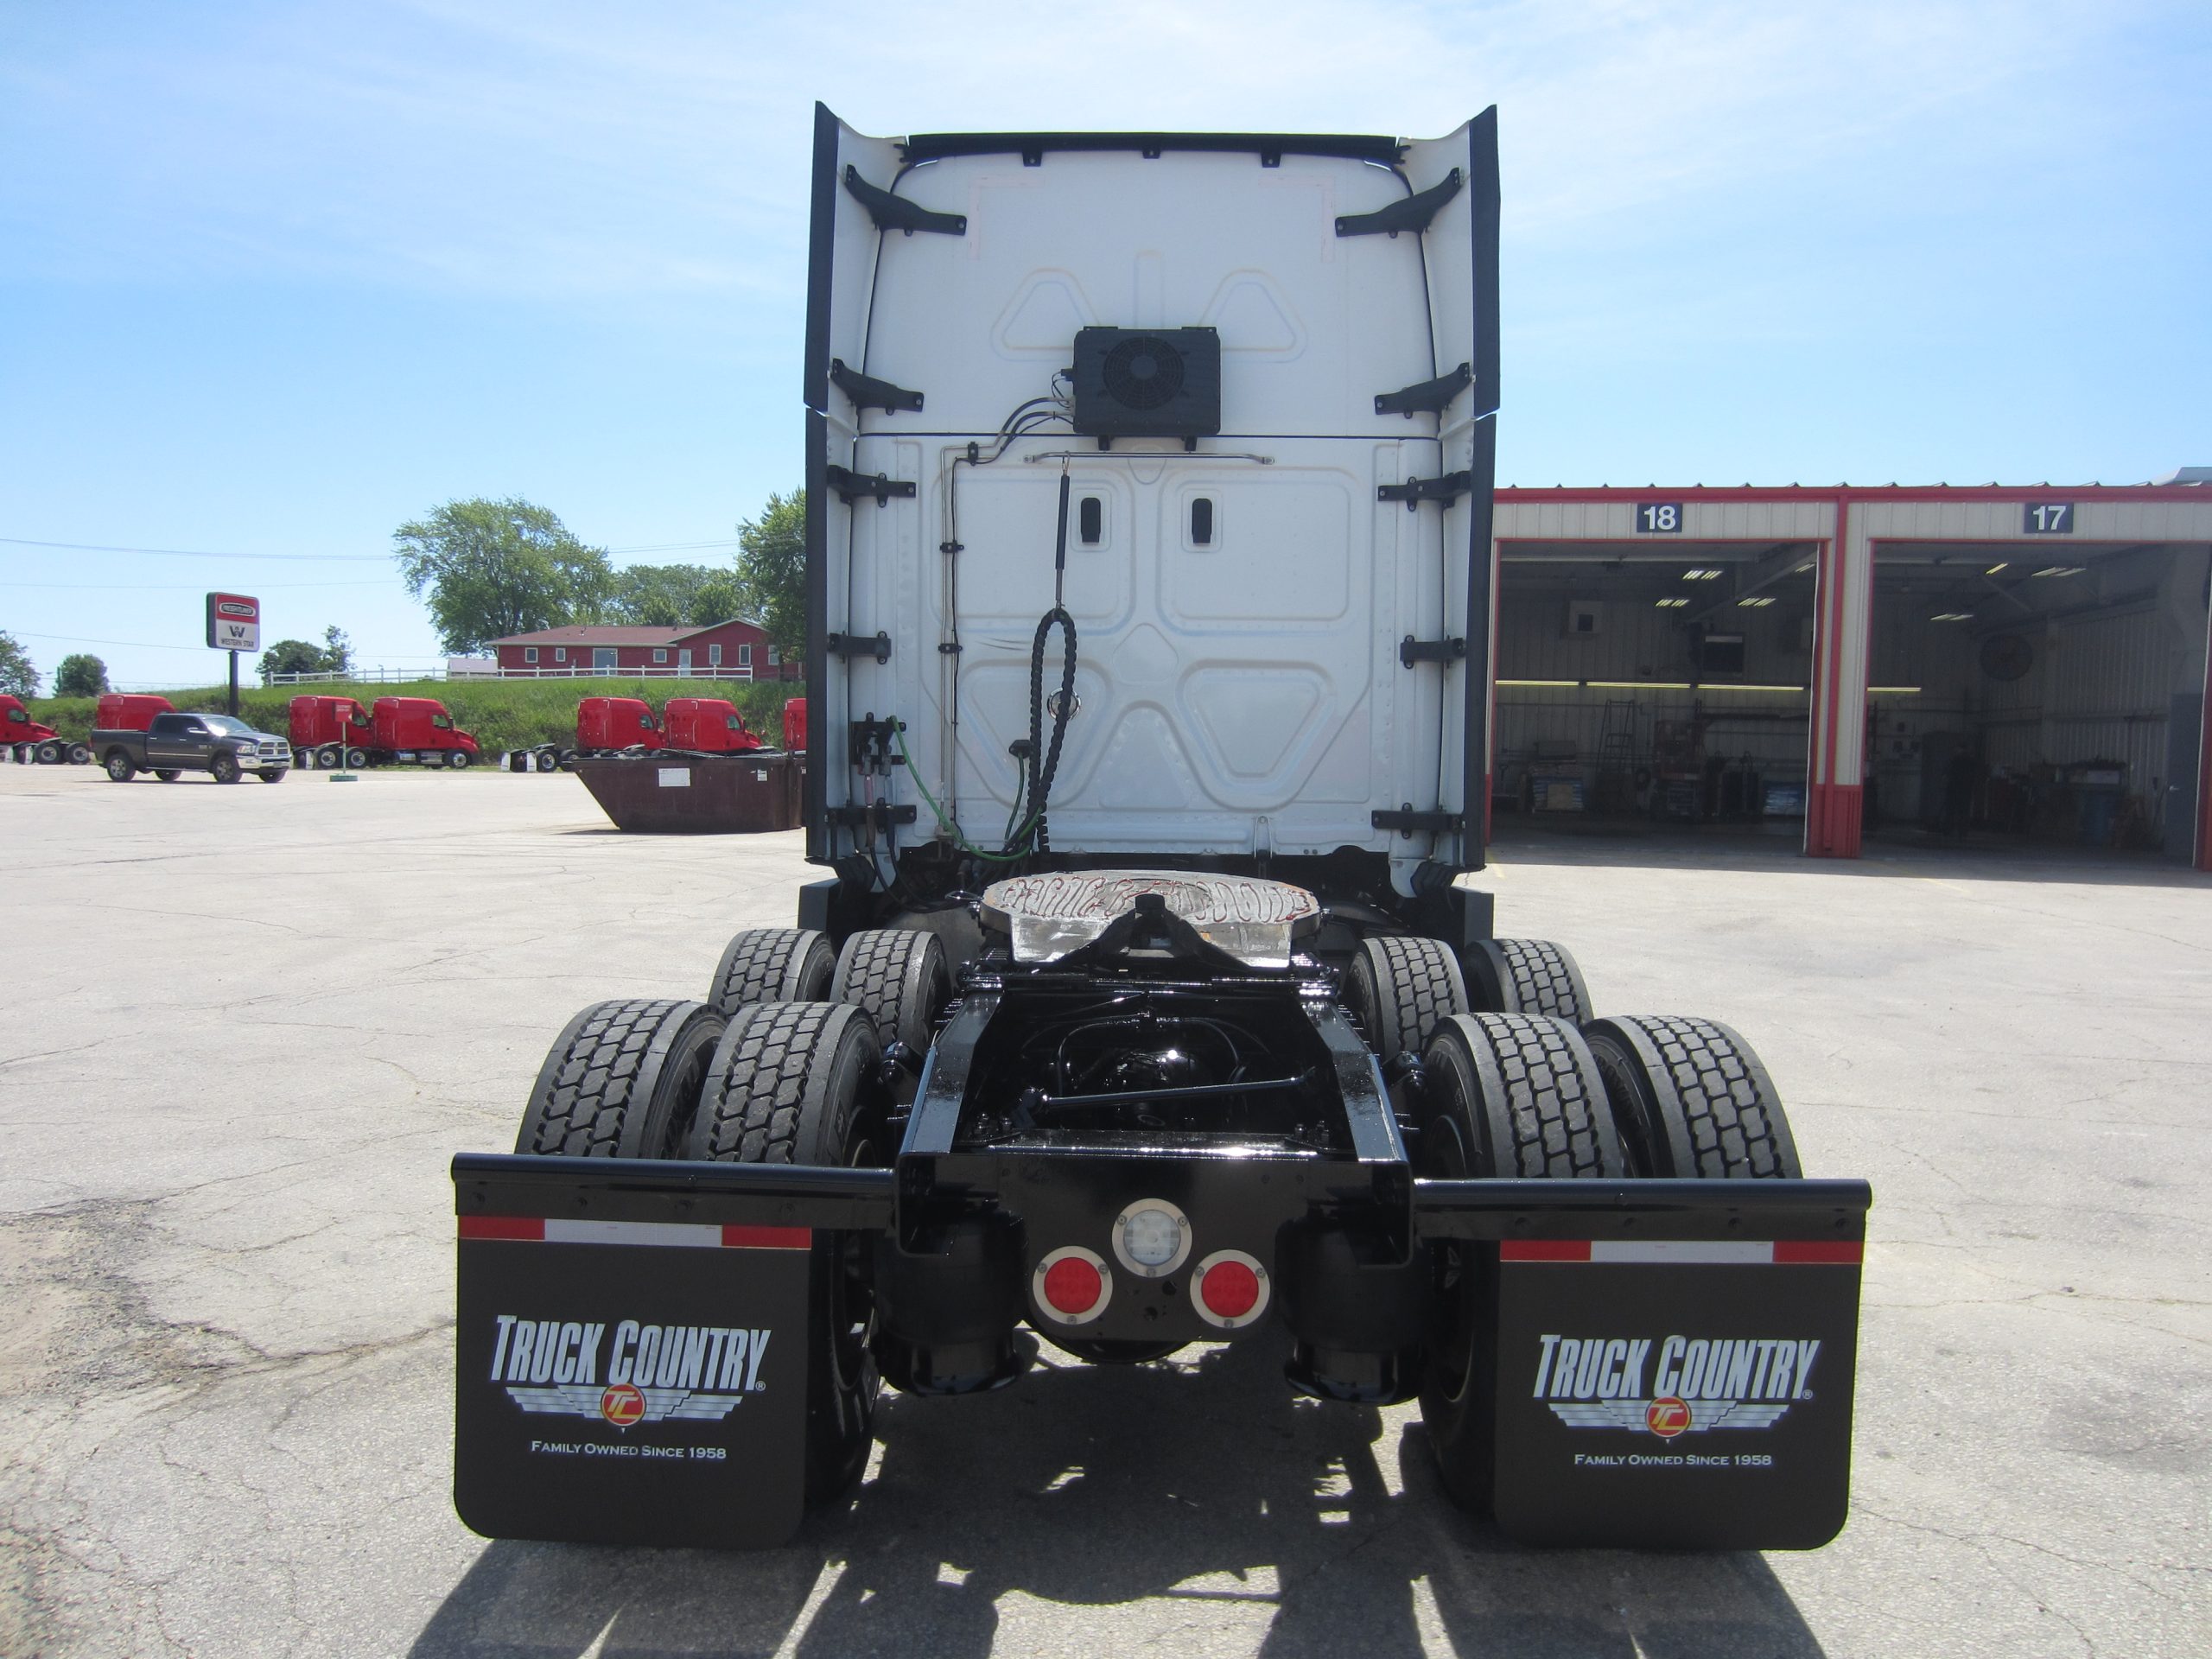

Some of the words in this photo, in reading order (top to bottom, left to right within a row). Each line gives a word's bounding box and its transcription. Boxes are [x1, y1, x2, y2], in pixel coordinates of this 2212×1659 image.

[1643, 505, 1676, 530] 18
[2032, 505, 2067, 531] 17
[491, 1314, 606, 1383] TRUCK
[1533, 1334, 1652, 1399] TRUCK
[531, 1440, 582, 1453] FAMILY
[584, 1443, 639, 1456] OWNED
[641, 1446, 684, 1458] SINCE
[689, 1447, 727, 1459] 1958
[1574, 1454, 1626, 1465] FAMILY
[1628, 1454, 1683, 1465] OWNED
[1686, 1454, 1729, 1465] SINCE
[1734, 1454, 1772, 1466] 1958
